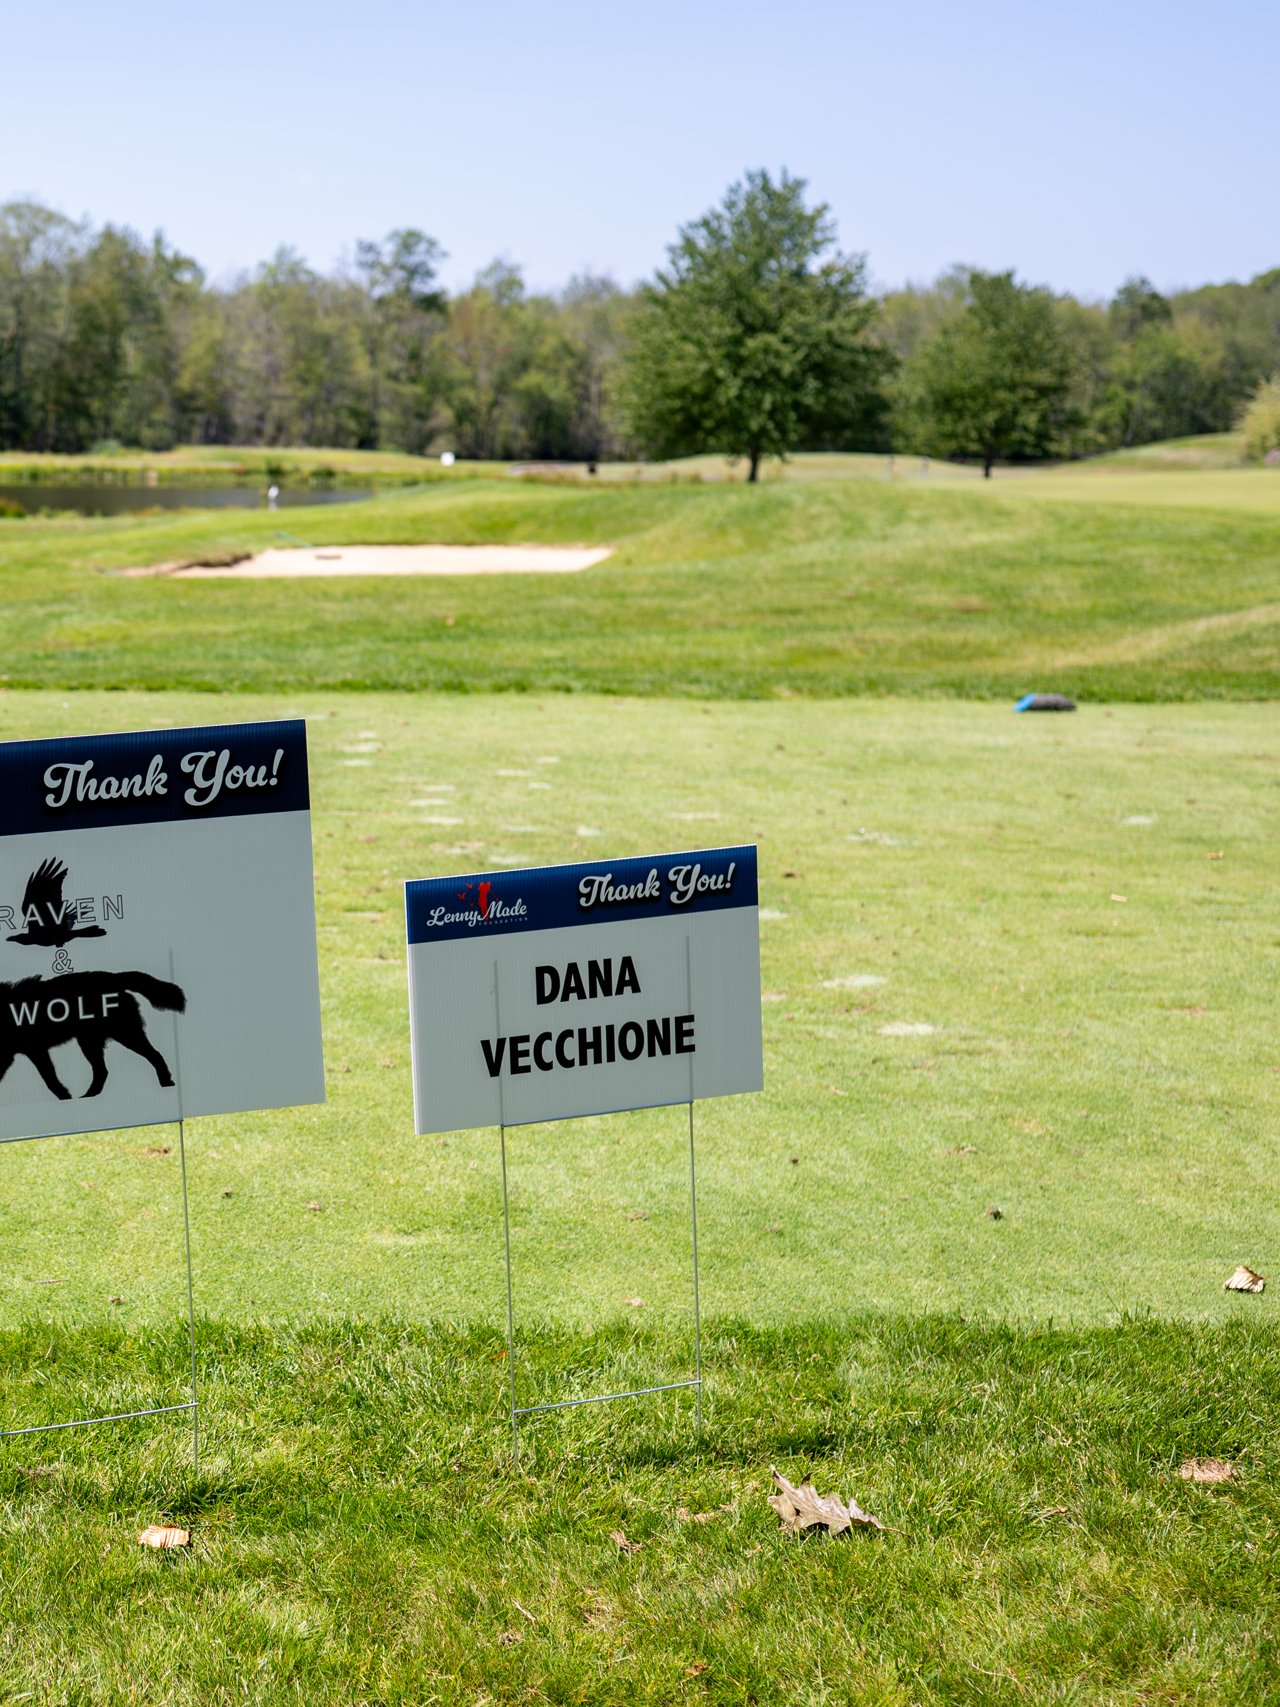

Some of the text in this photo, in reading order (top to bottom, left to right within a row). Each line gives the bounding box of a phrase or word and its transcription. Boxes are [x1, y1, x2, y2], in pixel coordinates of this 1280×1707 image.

[44, 748, 284, 807] Thank You!
[578, 862, 736, 907] Thank You!
[52, 949, 74, 974] &
[535, 955, 641, 1005] DANA
[9, 992, 119, 1026] WOLF
[480, 1014, 696, 1078] VECCHIONE
